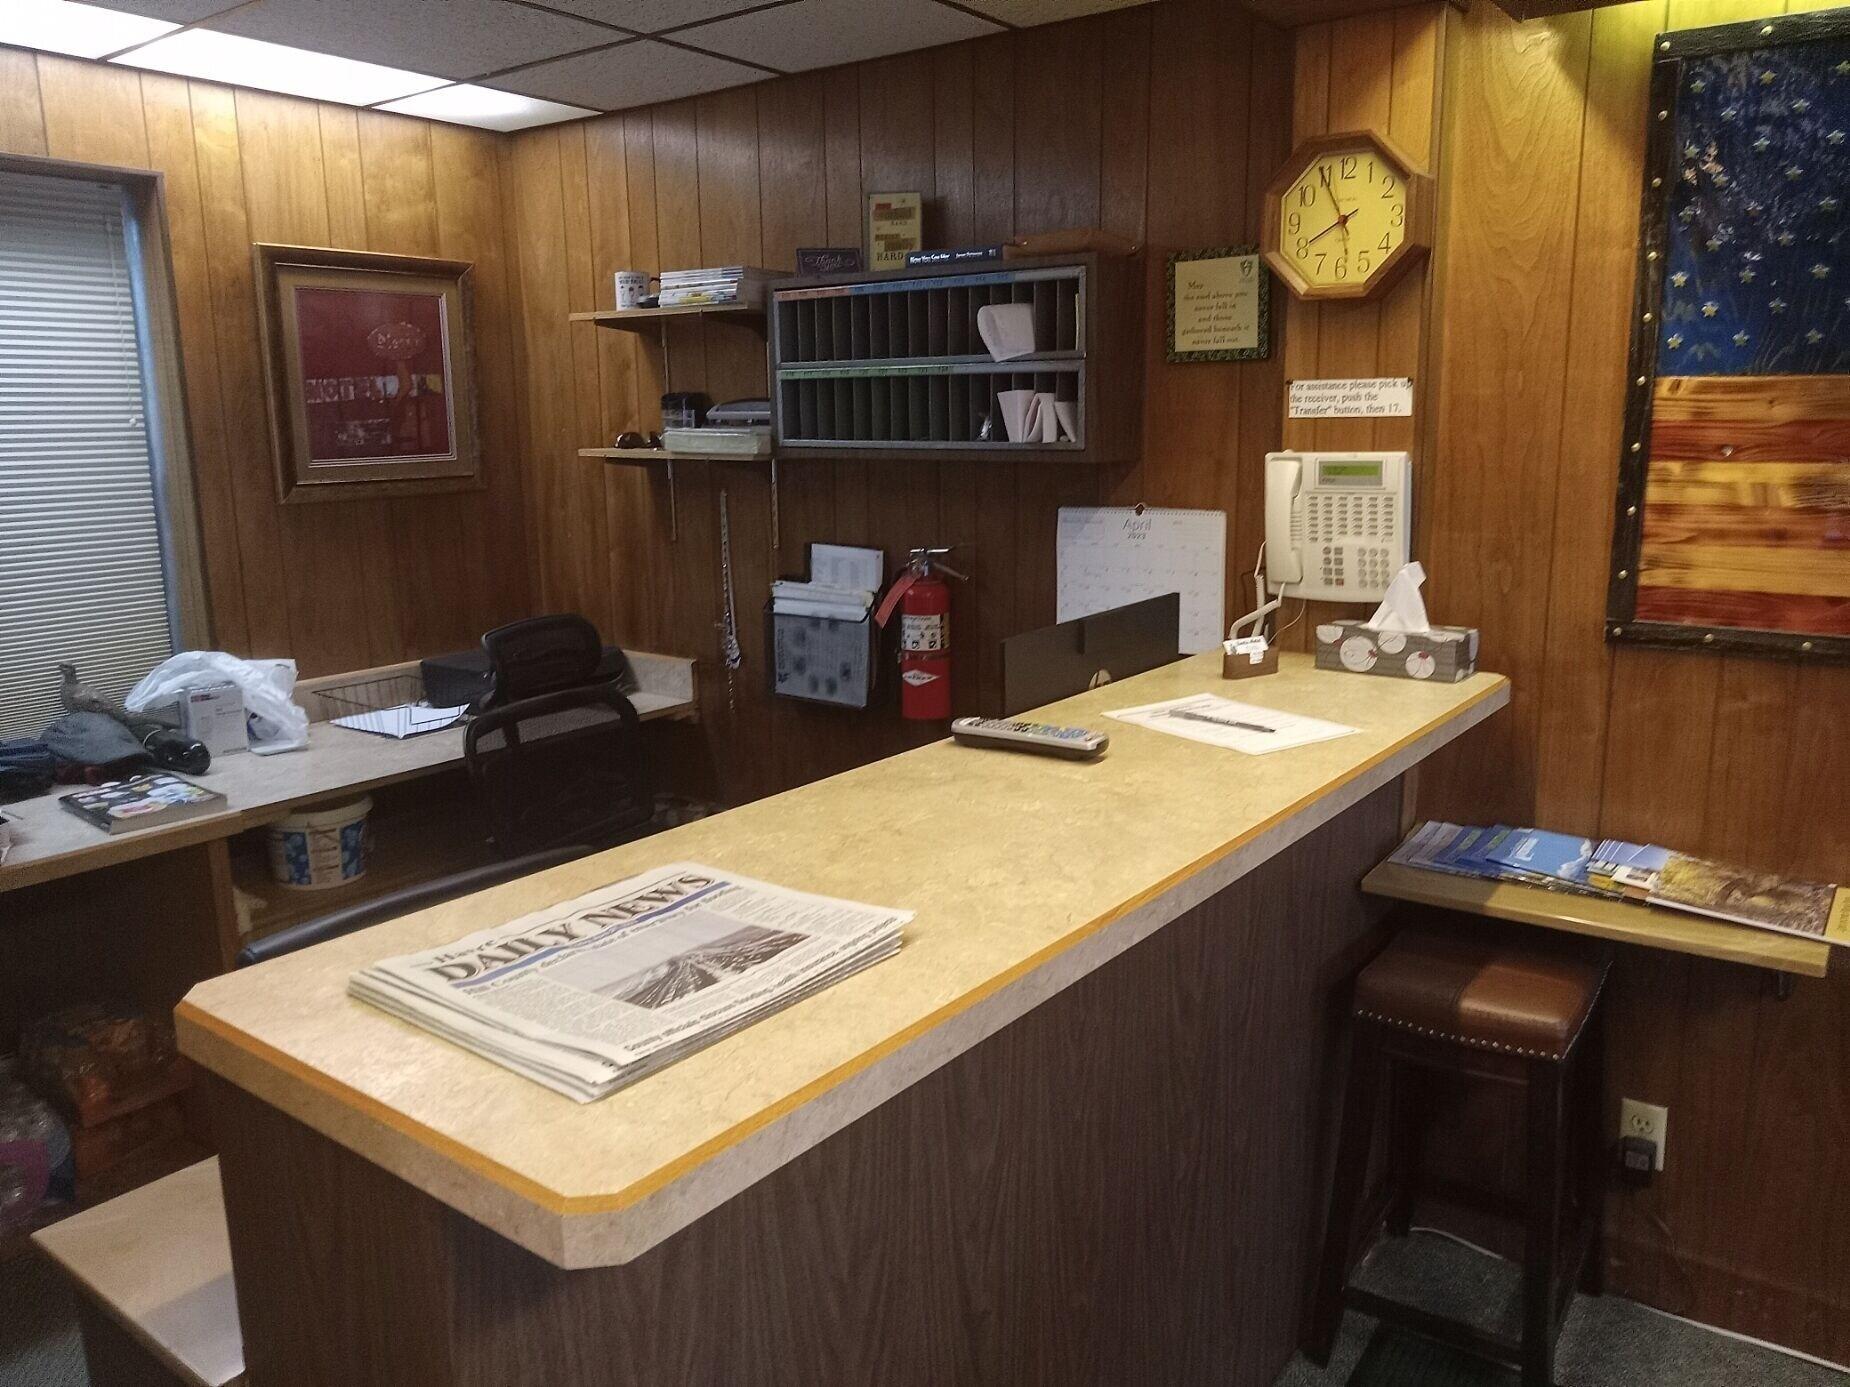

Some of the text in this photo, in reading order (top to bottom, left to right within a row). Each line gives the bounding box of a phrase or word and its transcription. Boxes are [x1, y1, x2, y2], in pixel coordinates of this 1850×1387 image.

[1319, 164, 1333, 188] 11
[1340, 157, 1357, 180] 12
[1367, 162, 1374, 184] 1
[1299, 184, 1316, 208] 10
[1381, 176, 1395, 199] 2
[1288, 213, 1300, 235] 9
[1390, 204, 1403, 227] 3
[1296, 237, 1309, 260] 8
[1377, 232, 1391, 255] 4
[1315, 253, 1328, 276] 7
[1334, 257, 1347, 280] 6
[1357, 251, 1371, 274] 5
[1306, 381, 1347, 391] assistance
[1349, 379, 1377, 392] please
[1378, 378, 1398, 390] pick
[1400, 380, 1413, 391] up
[1304, 392, 1340, 404] receiver,
[1341, 392, 1362, 404] push
[1364, 391, 1378, 401] the
[1365, 403, 1386, 413] then
[1121, 517, 1152, 531] April
[429, 874, 715, 981] DAILY NEWS
[434, 938, 495, 963] Havre
